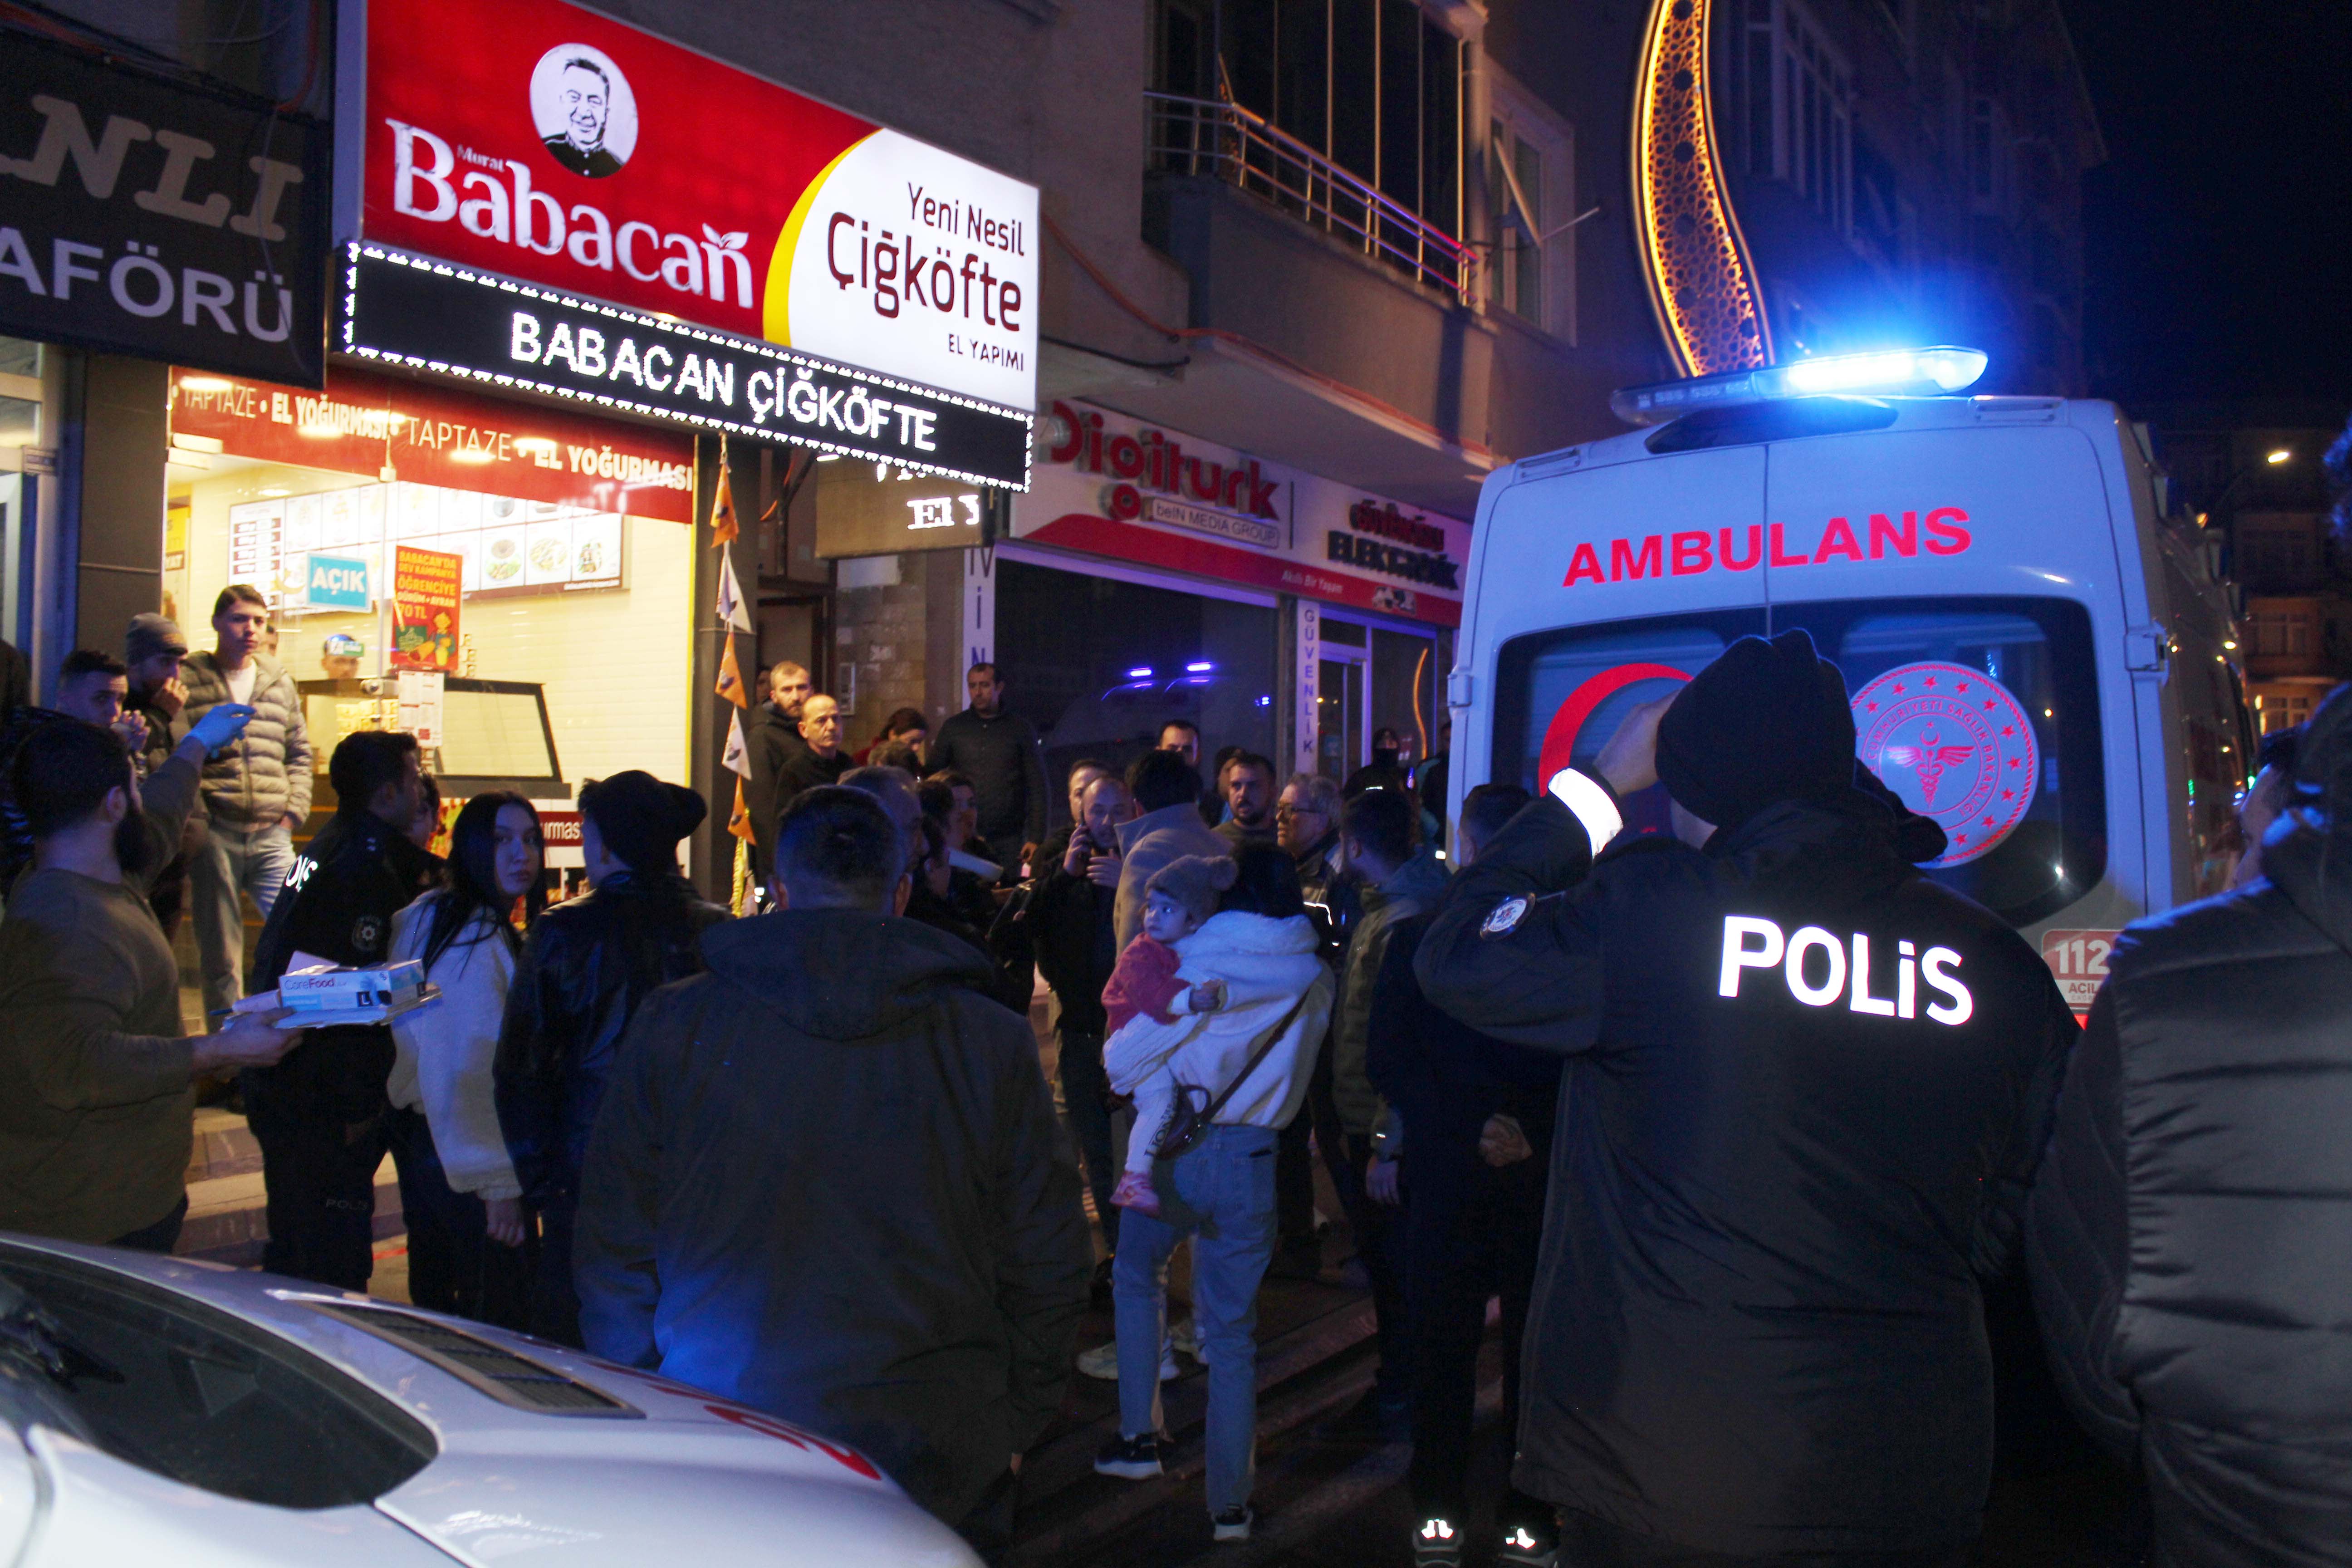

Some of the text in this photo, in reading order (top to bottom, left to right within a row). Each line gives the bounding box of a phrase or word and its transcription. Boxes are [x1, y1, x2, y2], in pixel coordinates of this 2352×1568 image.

[0, 94, 304, 242] NLI
[457, 144, 505, 172] Murat
[908, 181, 1024, 257] Yeni Nesil
[827, 212, 1022, 333] Çiğköfte
[511, 311, 937, 451] BABACAN ÇİĞKÖFTE
[948, 333, 1024, 372] EL YAPIMI
[272, 392, 293, 425] EL
[407, 416, 511, 462] TAPTAZE
[567, 445, 693, 492] YOĞURMASI
[311, 566, 366, 596] AÇIK
[1561, 506, 1972, 588] AMBULANS
[1947, 704, 1989, 742] SAĞLIK
[2054, 939, 2111, 974] 112
